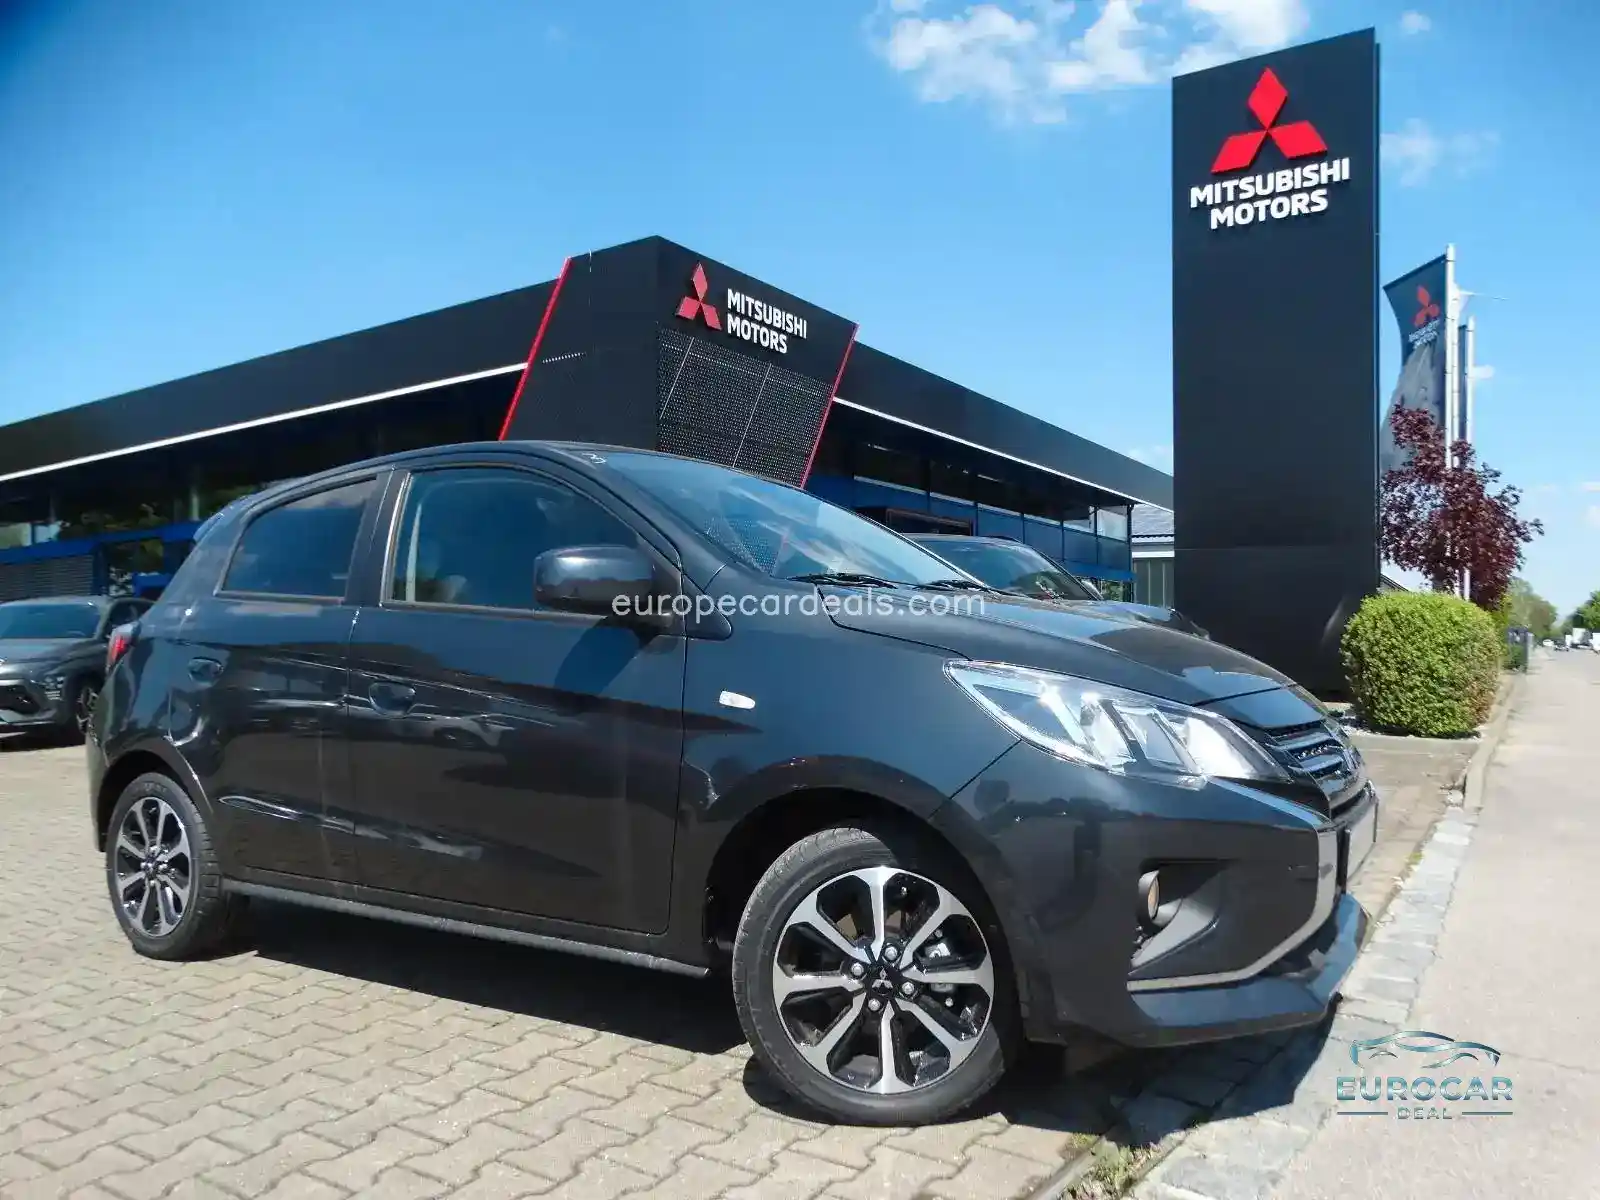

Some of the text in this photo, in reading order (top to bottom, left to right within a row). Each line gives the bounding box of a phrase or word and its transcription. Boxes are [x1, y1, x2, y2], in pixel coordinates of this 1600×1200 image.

[1190, 157, 1350, 208] MITSUBISHI
[1210, 189, 1328, 229] MOTORS
[727, 288, 807, 339] MITSUBISHI
[727, 313, 788, 354] MOTORS
